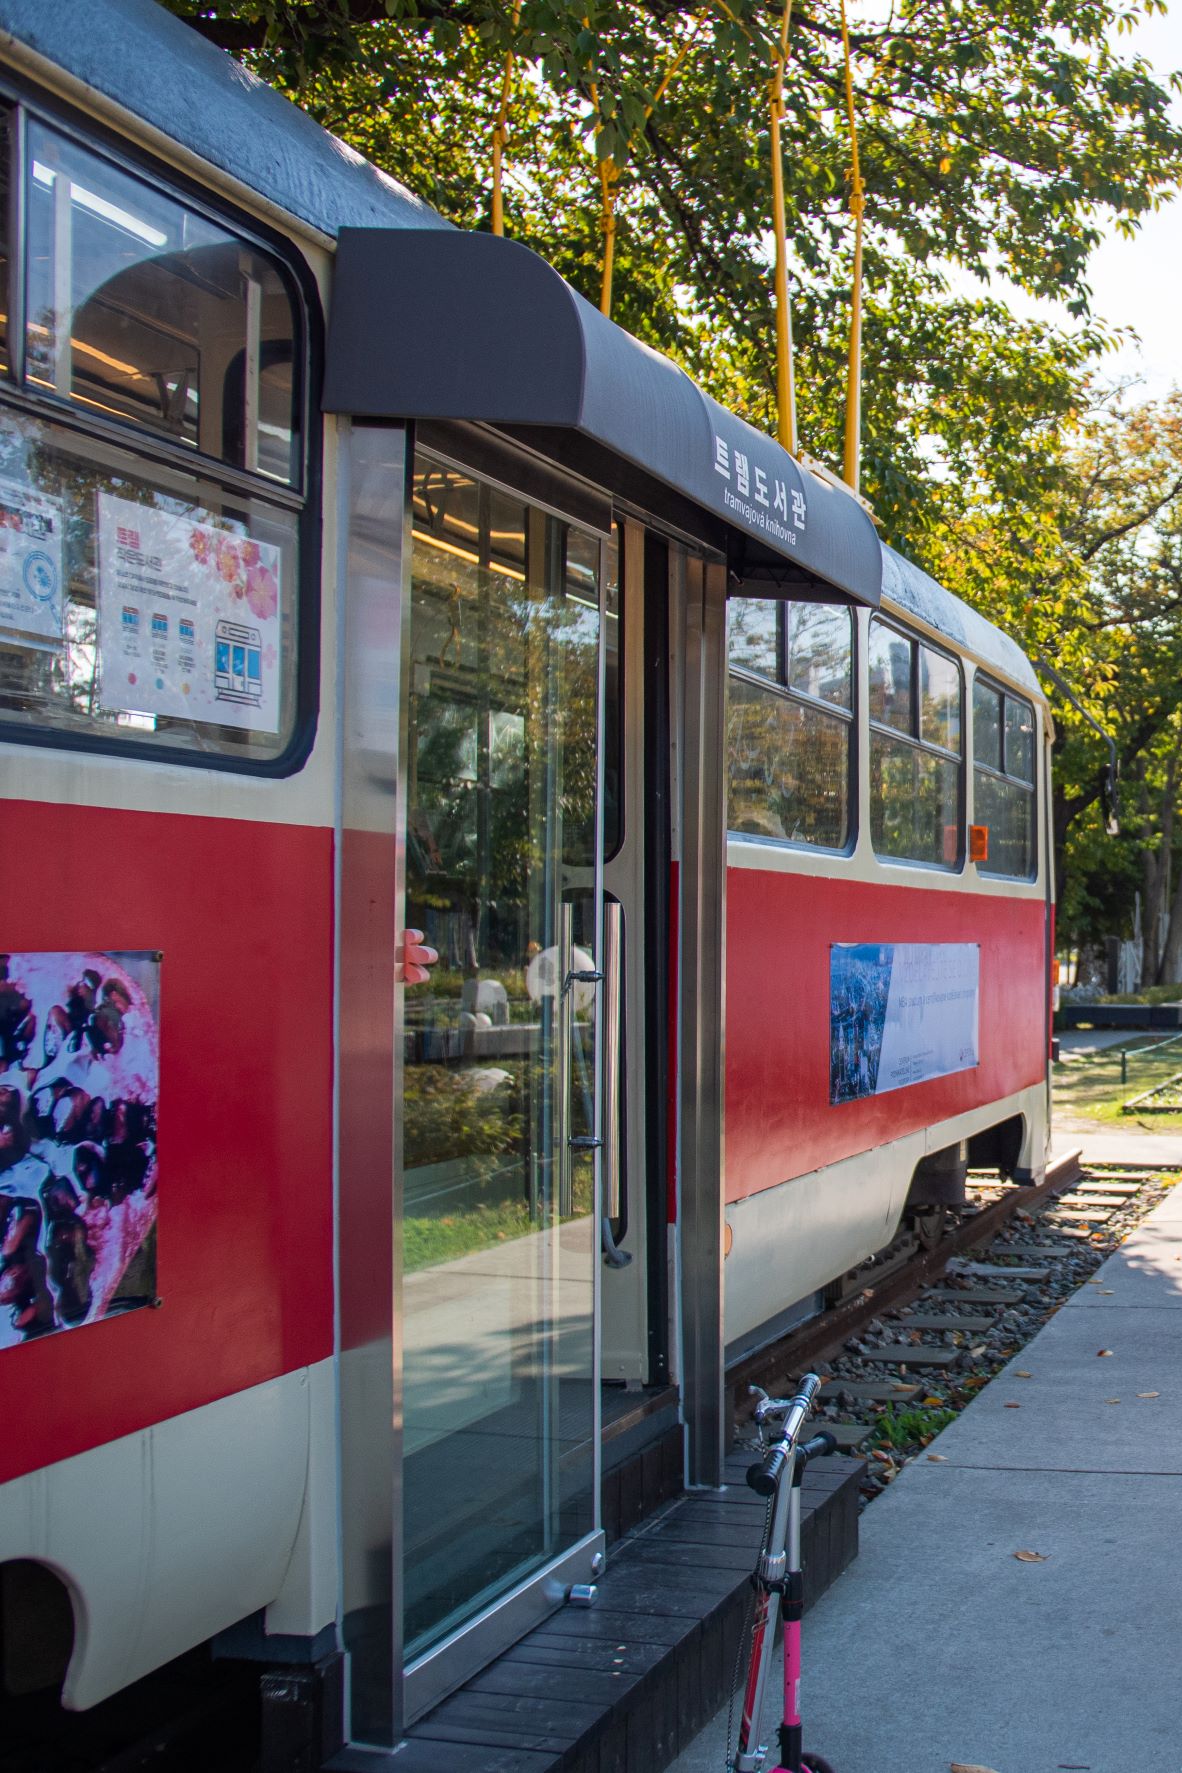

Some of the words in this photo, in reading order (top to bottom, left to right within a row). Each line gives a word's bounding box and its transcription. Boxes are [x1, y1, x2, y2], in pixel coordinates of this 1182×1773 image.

[714, 435, 807, 530] 트램도서관
[724, 487, 765, 528] tramvajová
[765, 514, 797, 546] knihovna
